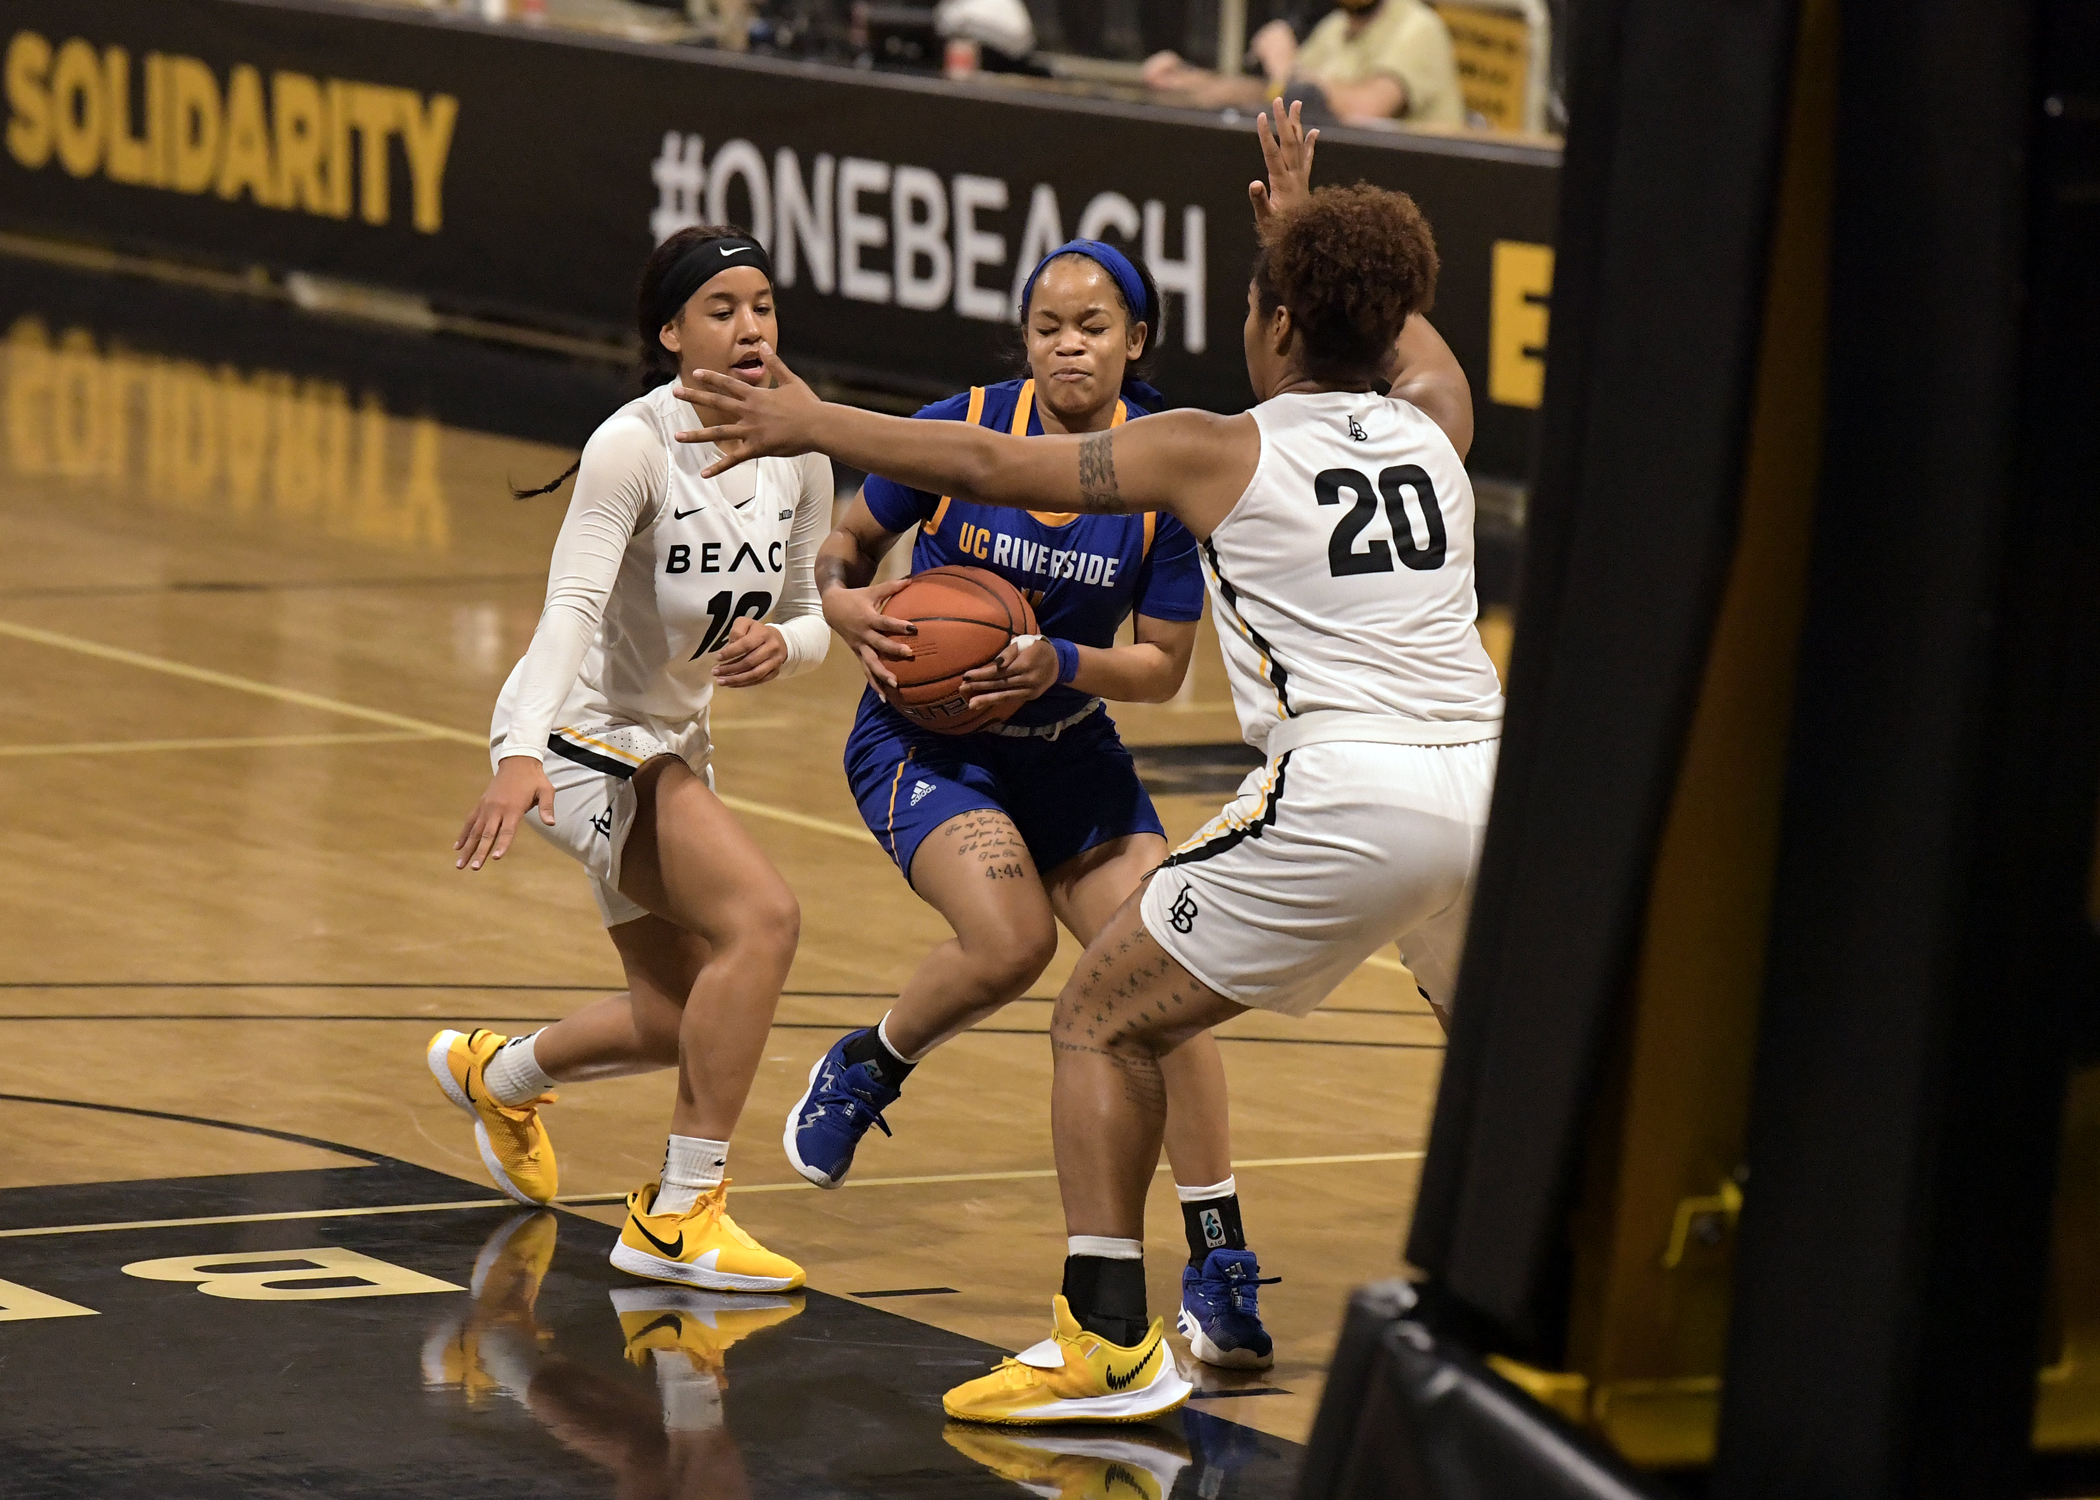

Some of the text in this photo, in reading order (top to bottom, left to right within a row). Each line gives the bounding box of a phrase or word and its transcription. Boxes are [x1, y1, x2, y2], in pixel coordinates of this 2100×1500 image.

[5, 31, 459, 235] SOLIDARITY
[1314, 464, 1447, 577] 20
[665, 540, 788, 574] BEAC
[959, 522, 1120, 588] UC RIVERSIDE
[910, 784, 937, 807] adidas
[986, 863, 1024, 879] 4:44
